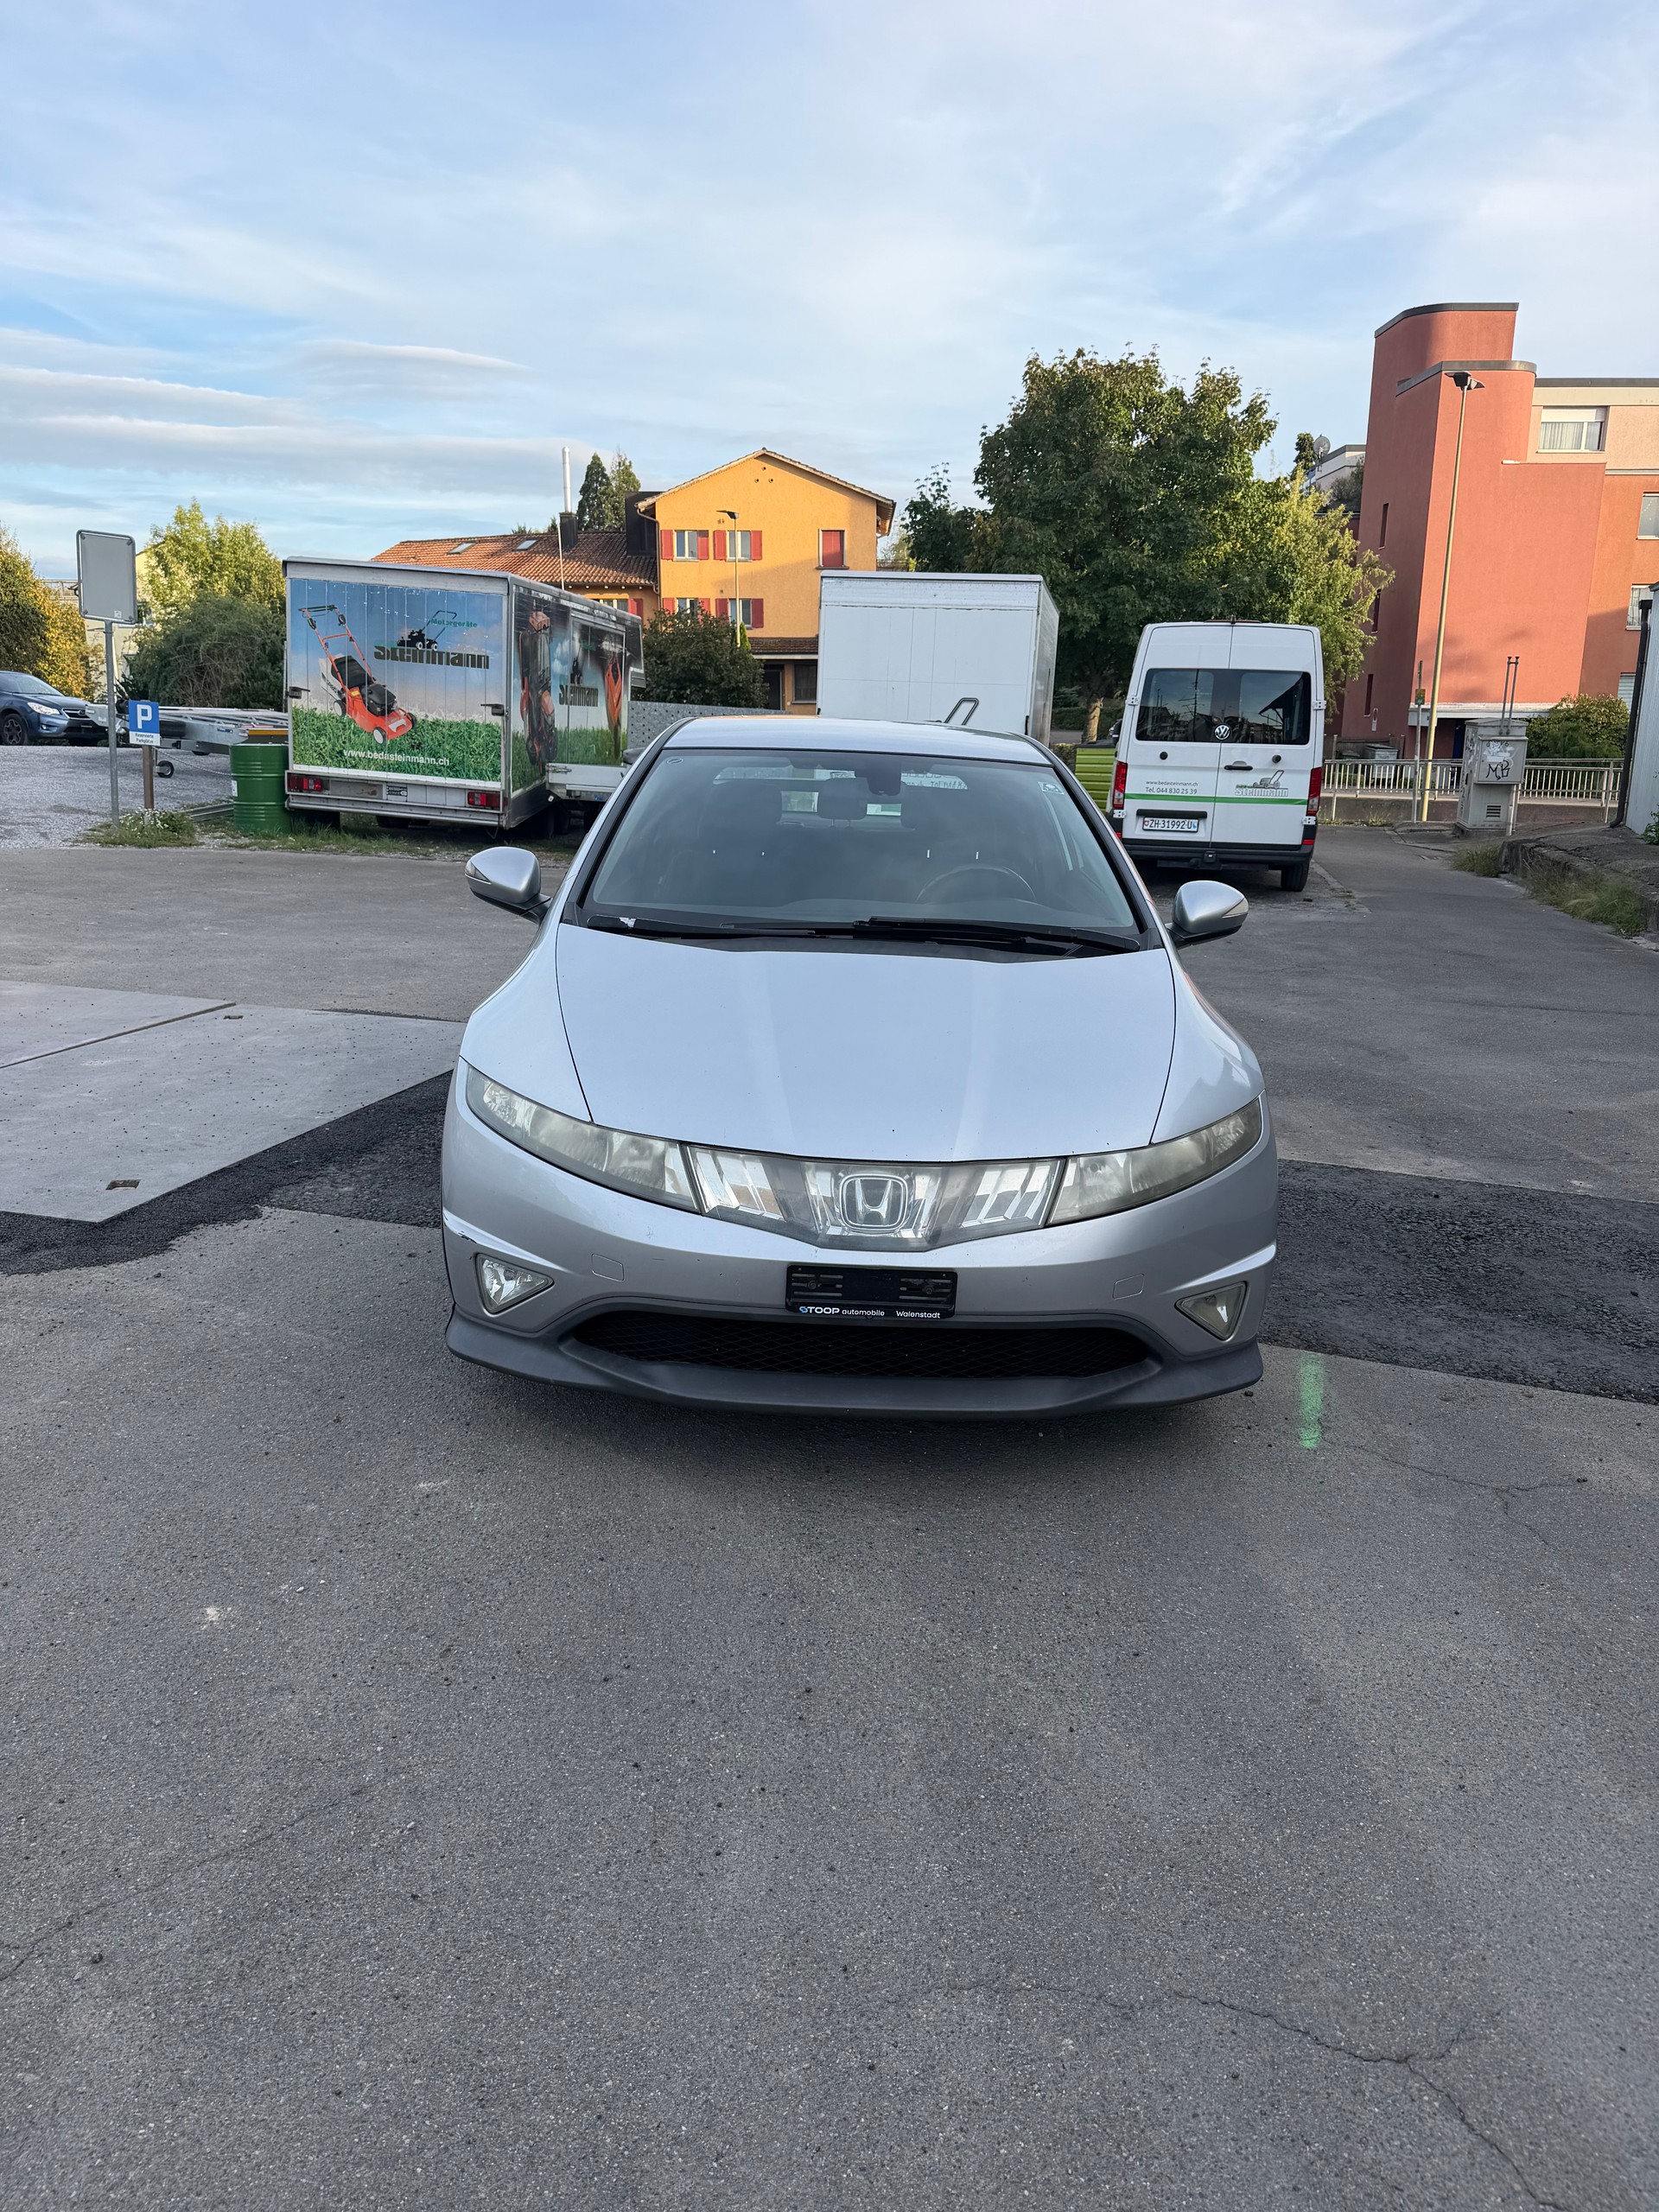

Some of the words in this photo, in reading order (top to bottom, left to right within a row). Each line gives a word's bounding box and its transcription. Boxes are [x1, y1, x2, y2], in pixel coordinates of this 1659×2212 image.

[430, 618, 478, 628] Motorgeräte
[137, 703, 152, 729] P
[343, 749, 450, 766] www.bedasteinmann.ch
[1235, 787, 1289, 798] Steinmann
[896, 1310, 941, 1319] Walenstadt
